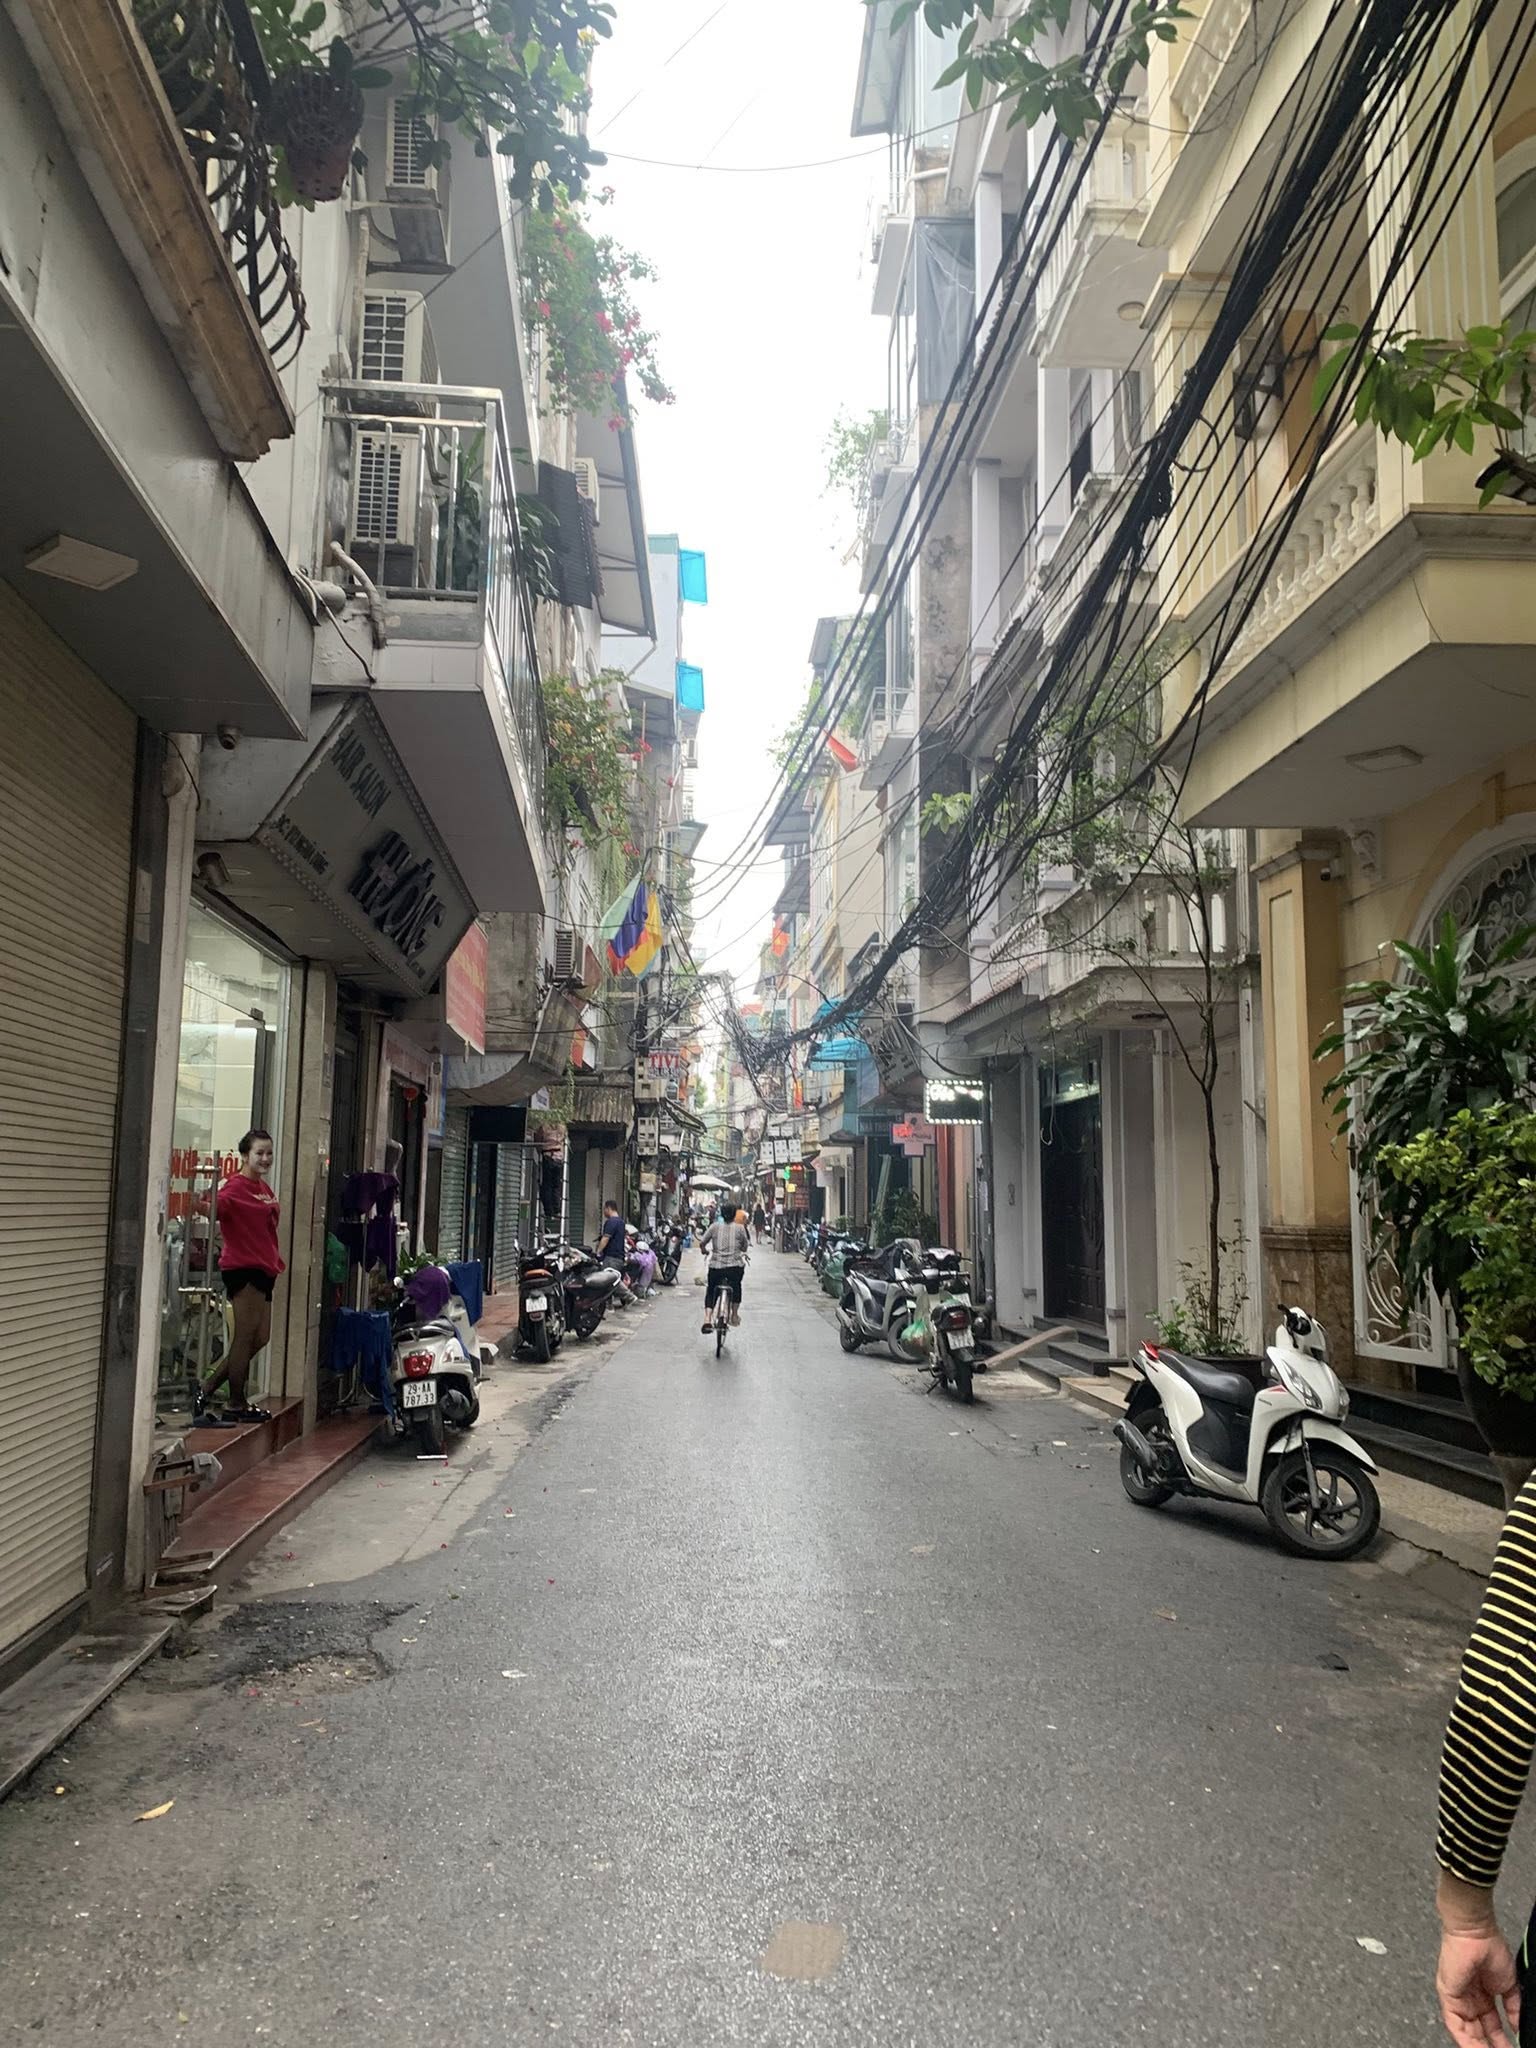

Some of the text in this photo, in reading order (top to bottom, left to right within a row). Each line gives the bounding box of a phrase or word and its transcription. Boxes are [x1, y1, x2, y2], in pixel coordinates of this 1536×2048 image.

[350, 763, 391, 818] SALON
[650, 1054, 679, 1069] TIVI
[406, 1393, 434, 1406] 787.33
